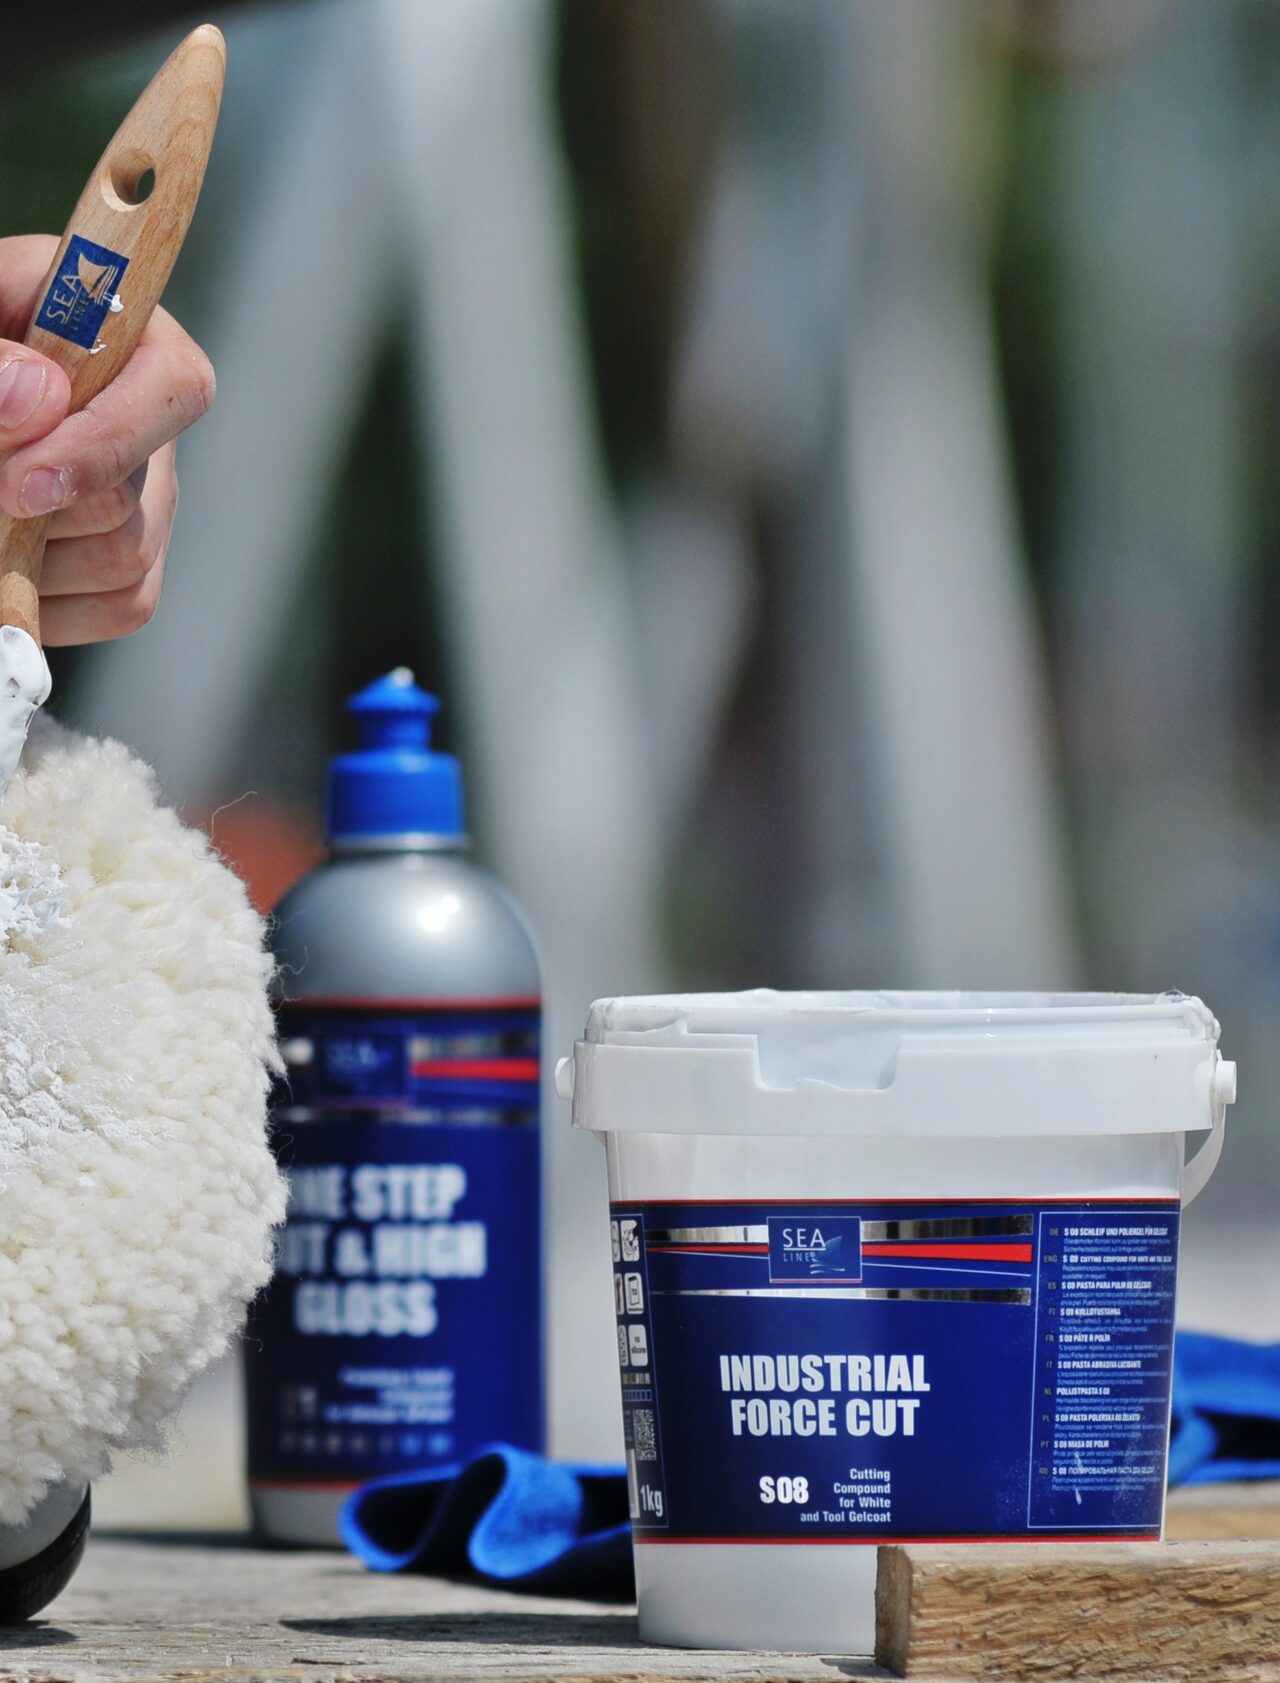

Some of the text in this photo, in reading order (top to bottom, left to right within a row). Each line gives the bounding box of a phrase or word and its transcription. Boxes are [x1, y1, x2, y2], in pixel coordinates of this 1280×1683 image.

[46, 273, 80, 324] SEA
[286, 1163, 467, 1221] NE STEP
[782, 1228, 826, 1248] SEA
[1080, 1227, 1105, 1237] SCHLEIF
[276, 1218, 486, 1280] UT & HIGH
[1076, 1281, 1095, 1291] PASTA
[294, 1279, 438, 1337] GLOSS
[719, 1354, 931, 1393] INDUSTRIAL
[1072, 1360, 1091, 1370] PASTA
[731, 1398, 920, 1437] FORCE CUT
[1069, 1413, 1088, 1423] PASTA
[849, 1468, 891, 1482] Cutting
[833, 1482, 891, 1495] Compound
[640, 1484, 664, 1518] 1kg
[839, 1497, 891, 1508] for White
[800, 1511, 892, 1522] and Tool Gelcoat
